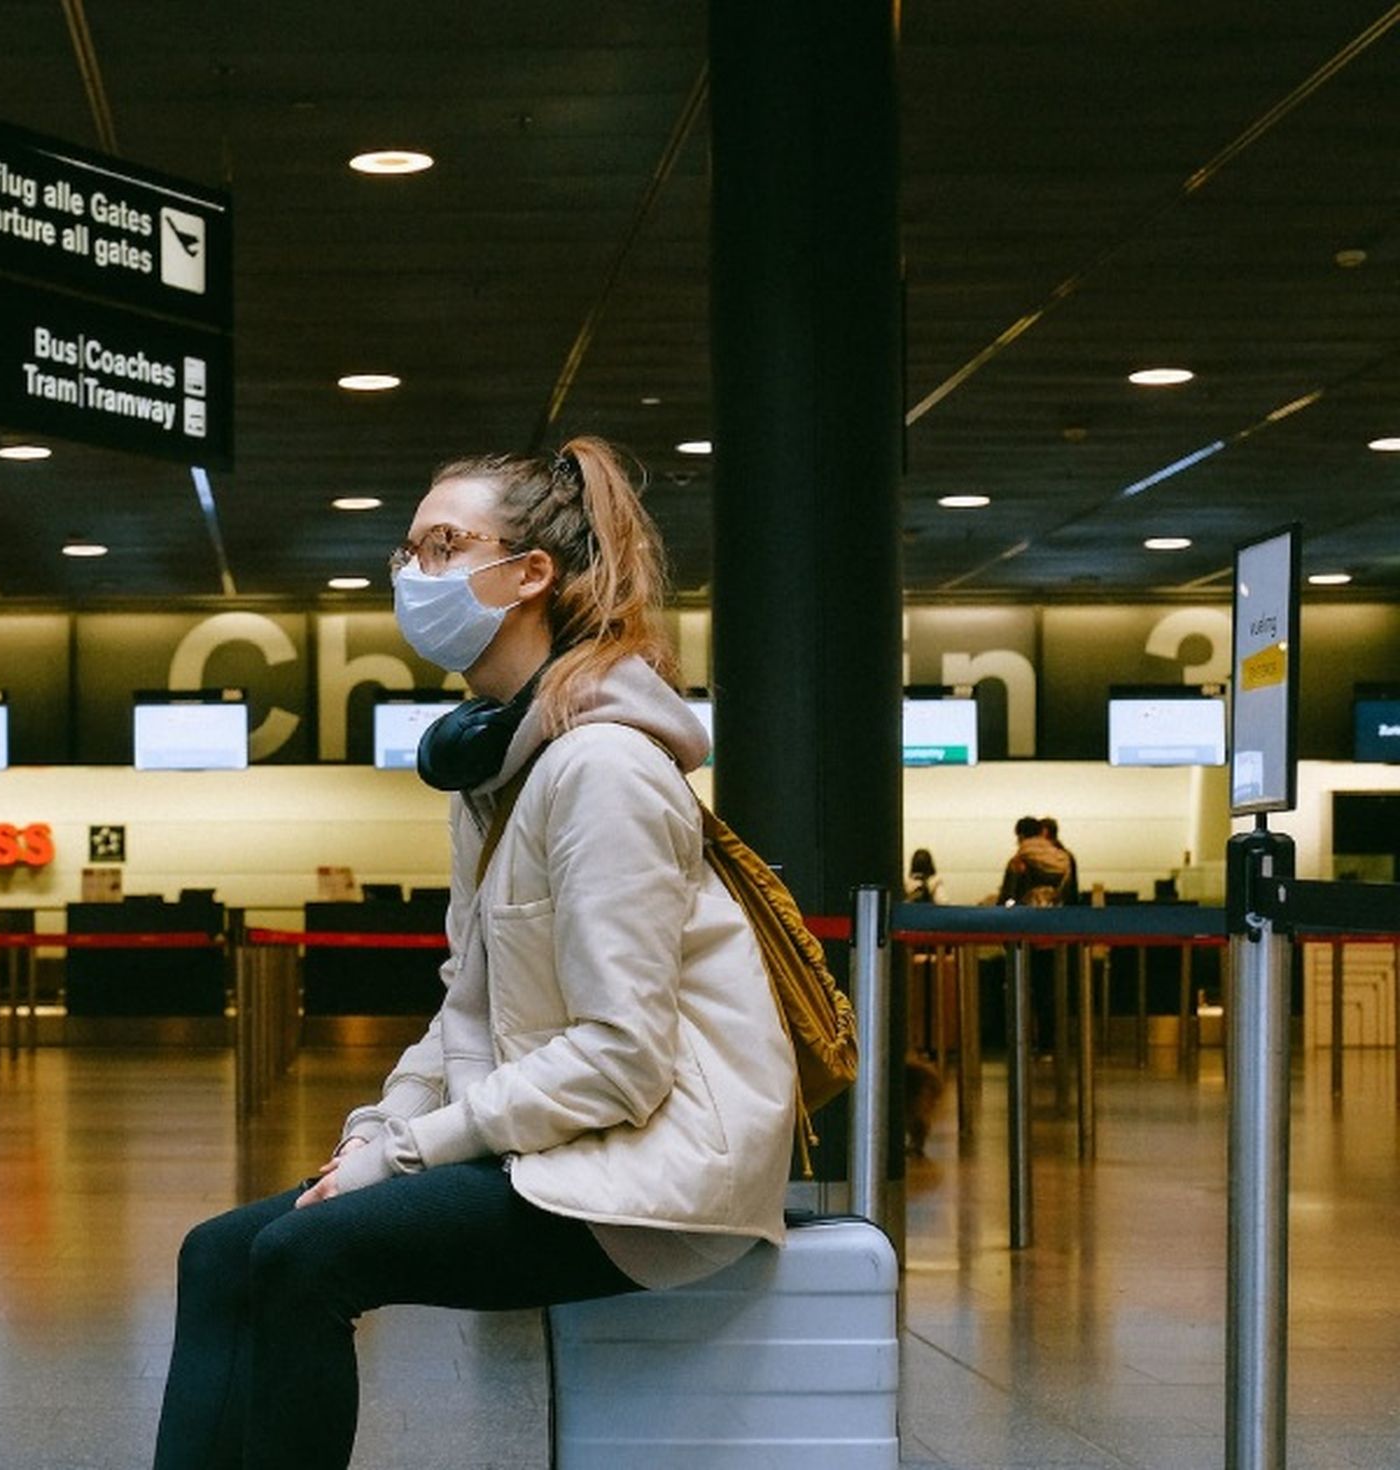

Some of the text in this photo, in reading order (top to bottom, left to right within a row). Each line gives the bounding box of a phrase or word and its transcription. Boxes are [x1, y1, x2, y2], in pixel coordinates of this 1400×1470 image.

[43, 180, 85, 216] alle
[90, 192, 153, 236] Gates
[61, 223, 90, 255] all
[94, 238, 153, 274] gates
